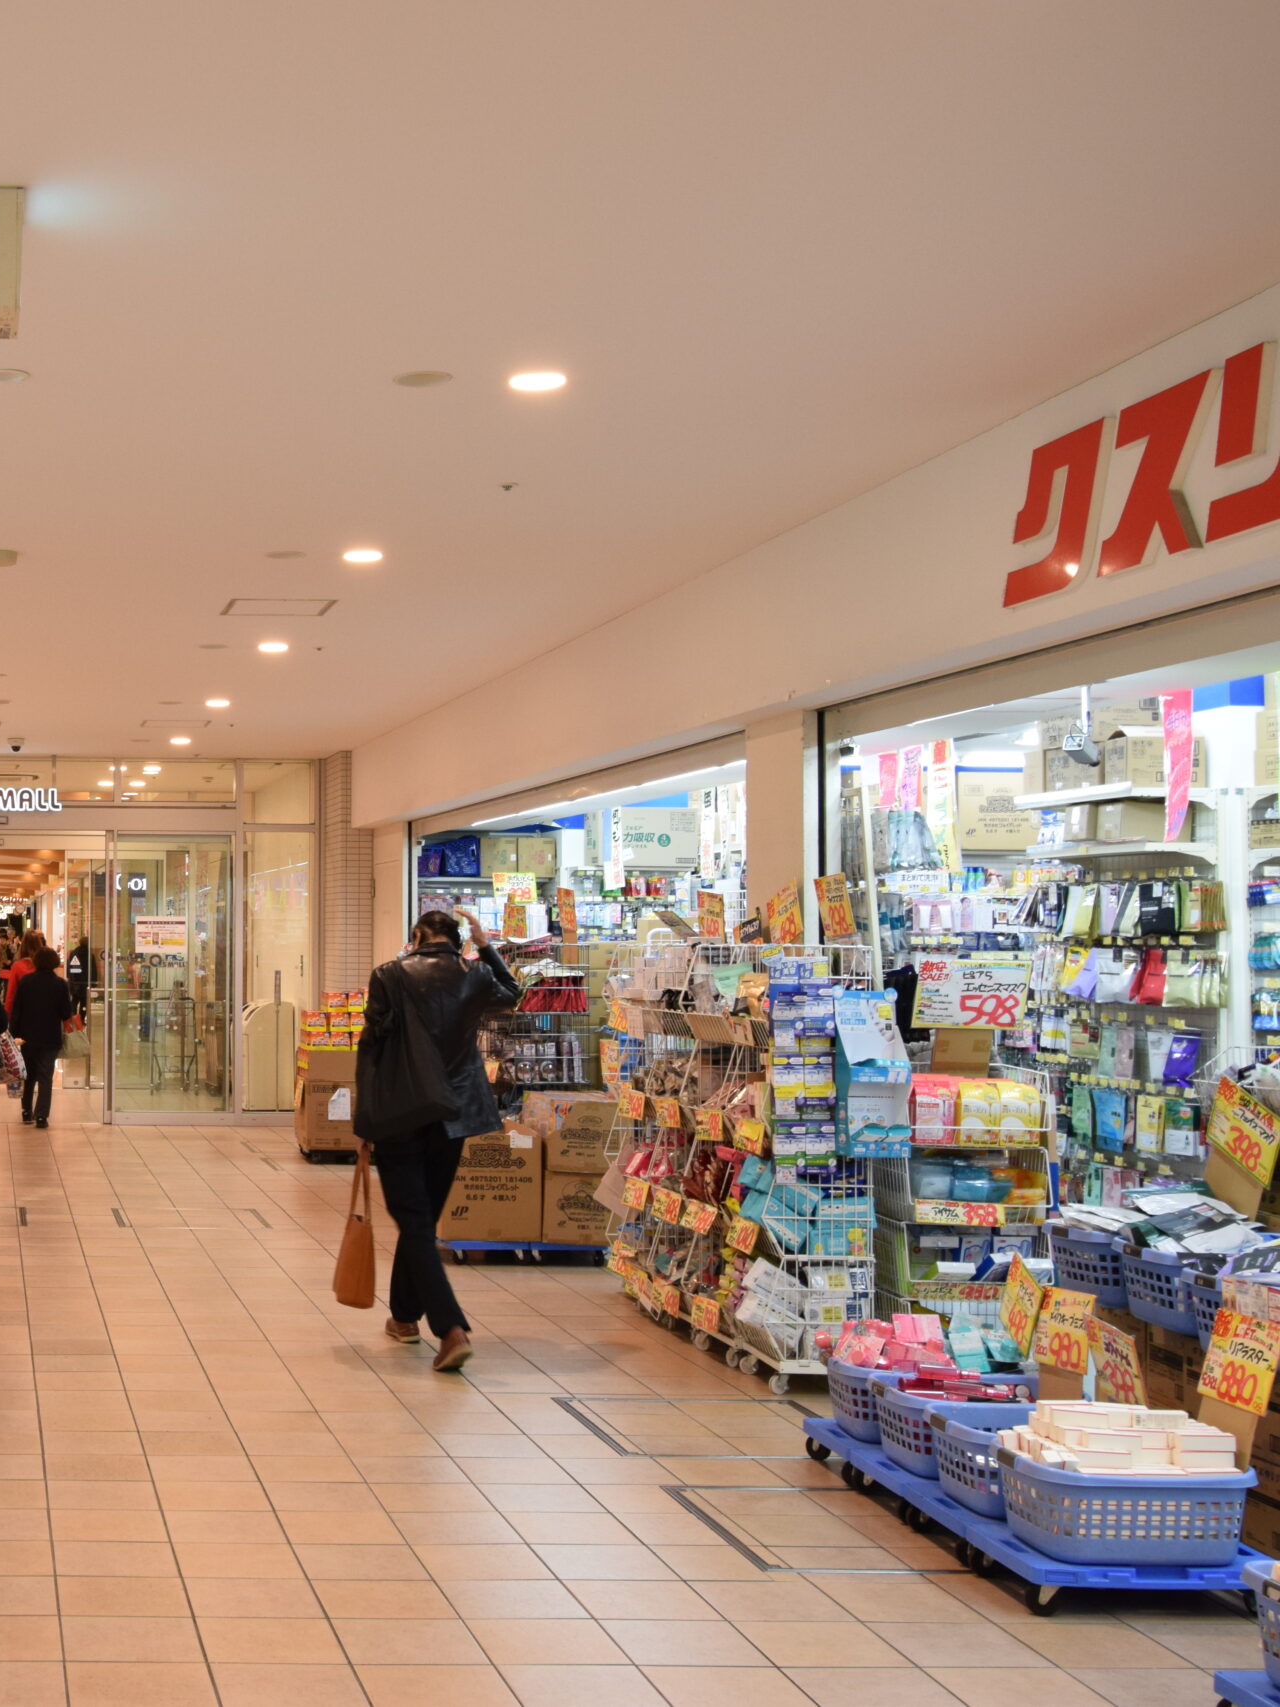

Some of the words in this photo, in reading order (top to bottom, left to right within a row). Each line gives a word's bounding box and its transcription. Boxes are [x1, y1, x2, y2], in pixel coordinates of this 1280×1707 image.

[959, 994, 1020, 1027] 598
[1225, 1125, 1263, 1172] 398
[1049, 1332, 1082, 1370] 980
[1216, 1360, 1258, 1407] 880
